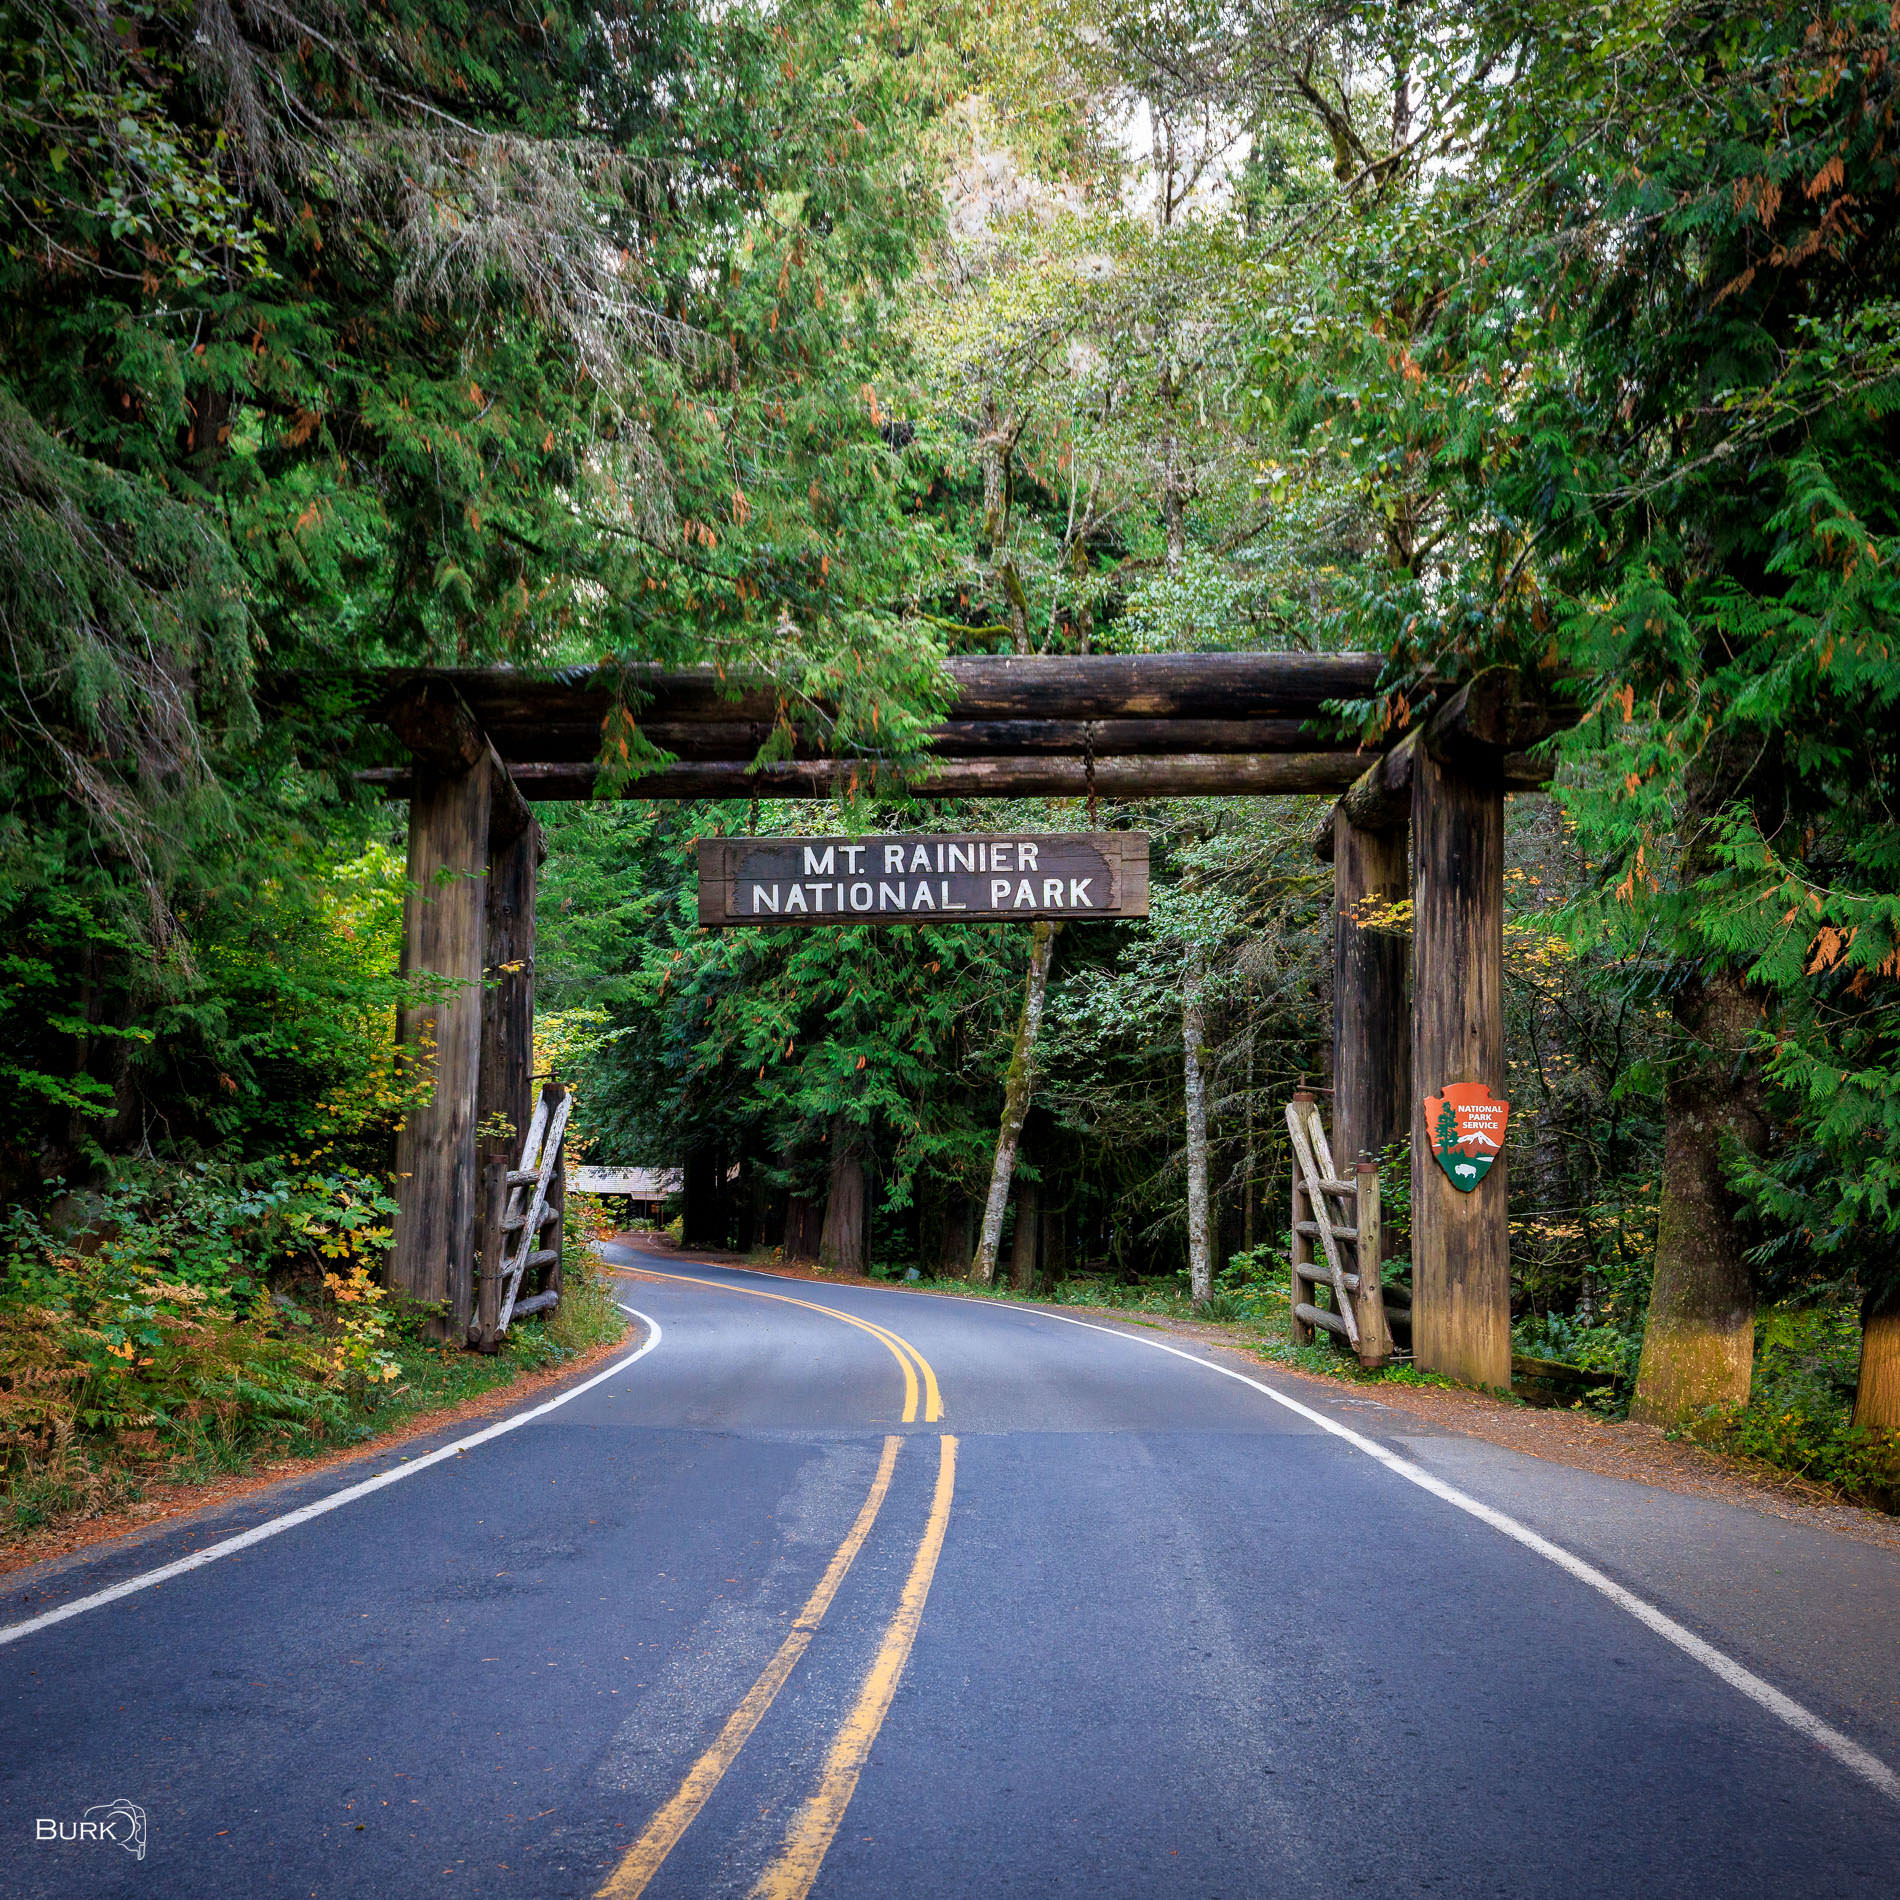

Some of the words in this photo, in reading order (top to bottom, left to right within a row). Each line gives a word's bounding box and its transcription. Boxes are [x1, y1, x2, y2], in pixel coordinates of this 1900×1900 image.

[803, 845, 865, 875] MT.
[884, 842, 1039, 873] RAINIER
[752, 880, 967, 913] NATIONAL
[990, 877, 1095, 909] PARK
[1458, 1105, 1503, 1113] NATIONAL
[1468, 1113, 1492, 1121] PARK
[1462, 1121, 1498, 1129] SERVICE
